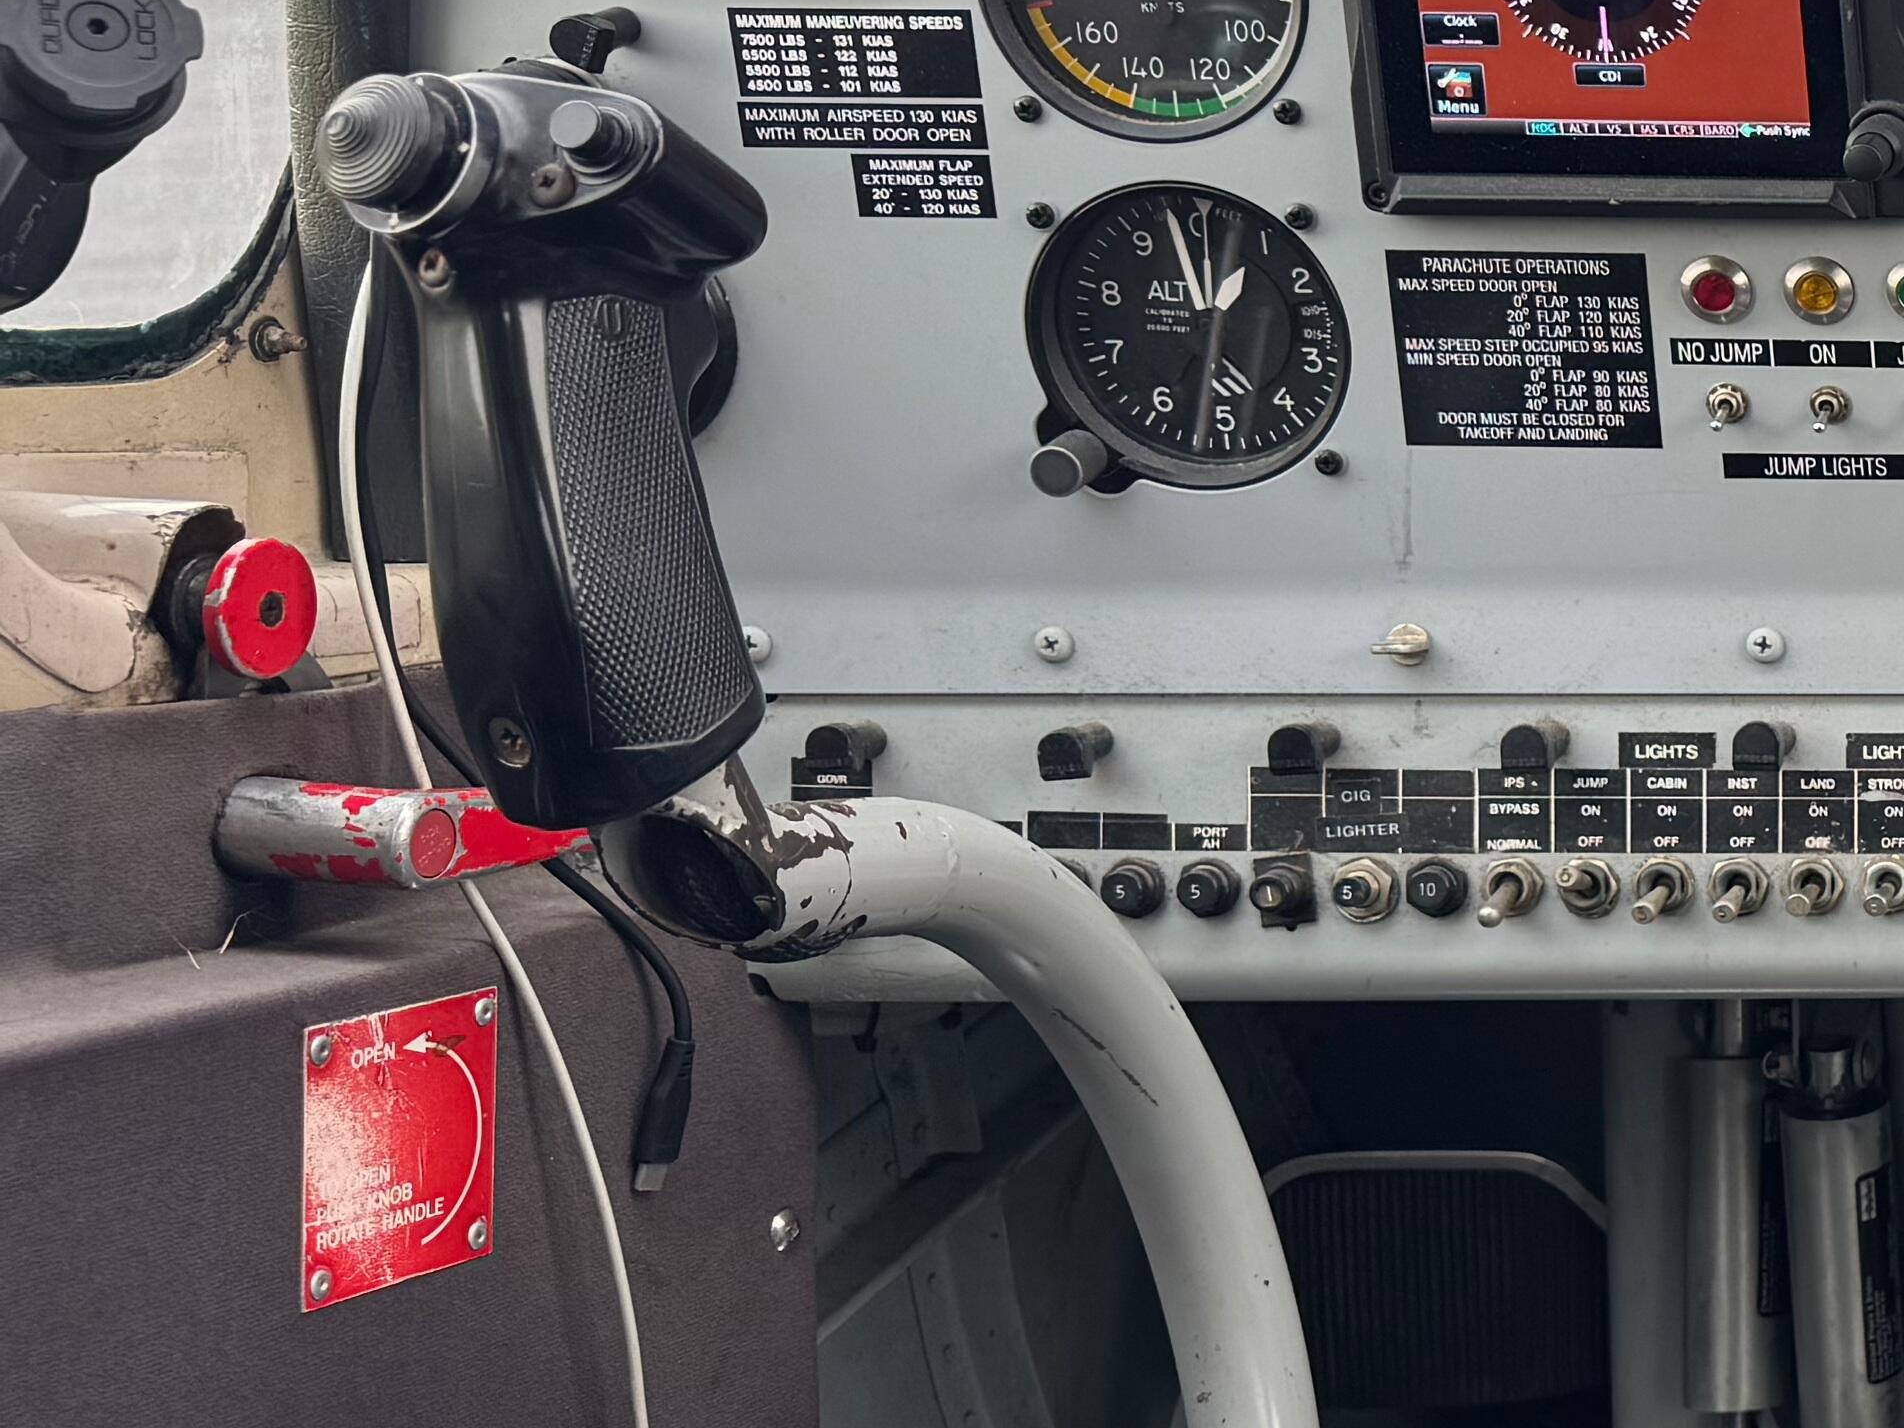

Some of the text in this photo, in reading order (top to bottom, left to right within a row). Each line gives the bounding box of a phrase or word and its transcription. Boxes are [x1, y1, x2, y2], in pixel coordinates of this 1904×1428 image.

[1075, 22, 1118, 42] 160
[1190, 60, 1230, 81] 120
[744, 107, 977, 125] MAXIMUM AIRSPEED 130 KIAS
[1422, 258, 1610, 276] PARACHUTE OPERATIONS
[1678, 342, 1763, 364] NO JUMP
[1810, 345, 1836, 364] ON
[1764, 457, 1887, 478] JUMP LIGHTS
[1634, 745, 1698, 760] LIGHTS
[1647, 777, 1687, 790] CABIN
[1326, 822, 1399, 838] LIGHTER
[351, 1043, 395, 1069] OPEN
